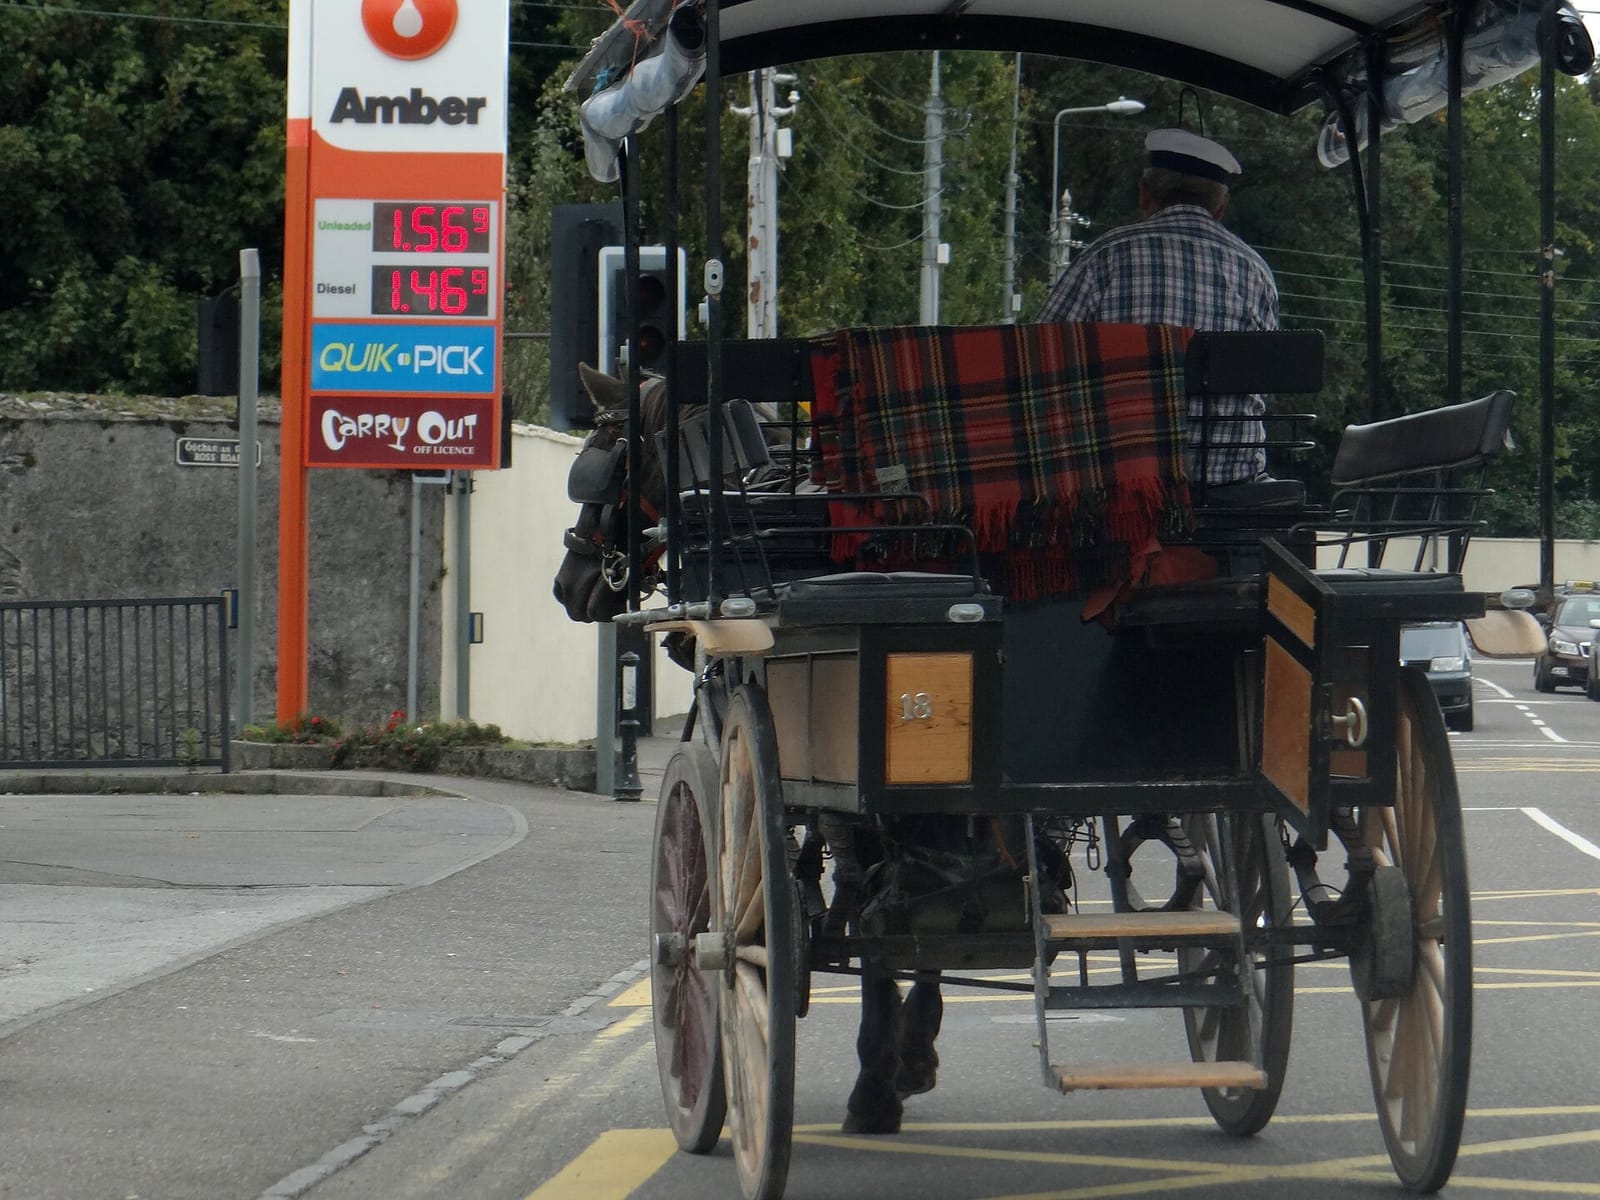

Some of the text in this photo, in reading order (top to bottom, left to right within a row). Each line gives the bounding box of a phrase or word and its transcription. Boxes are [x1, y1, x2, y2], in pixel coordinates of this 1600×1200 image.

[329, 87, 487, 125] Amber
[318, 221, 371, 231] Unleaded
[317, 283, 356, 295] Diesel
[319, 342, 485, 375] QUIK PICK
[413, 445, 475, 455] OFF LICENCE
[194, 452, 216, 461] ROSS
[900, 692, 932, 720] 18
